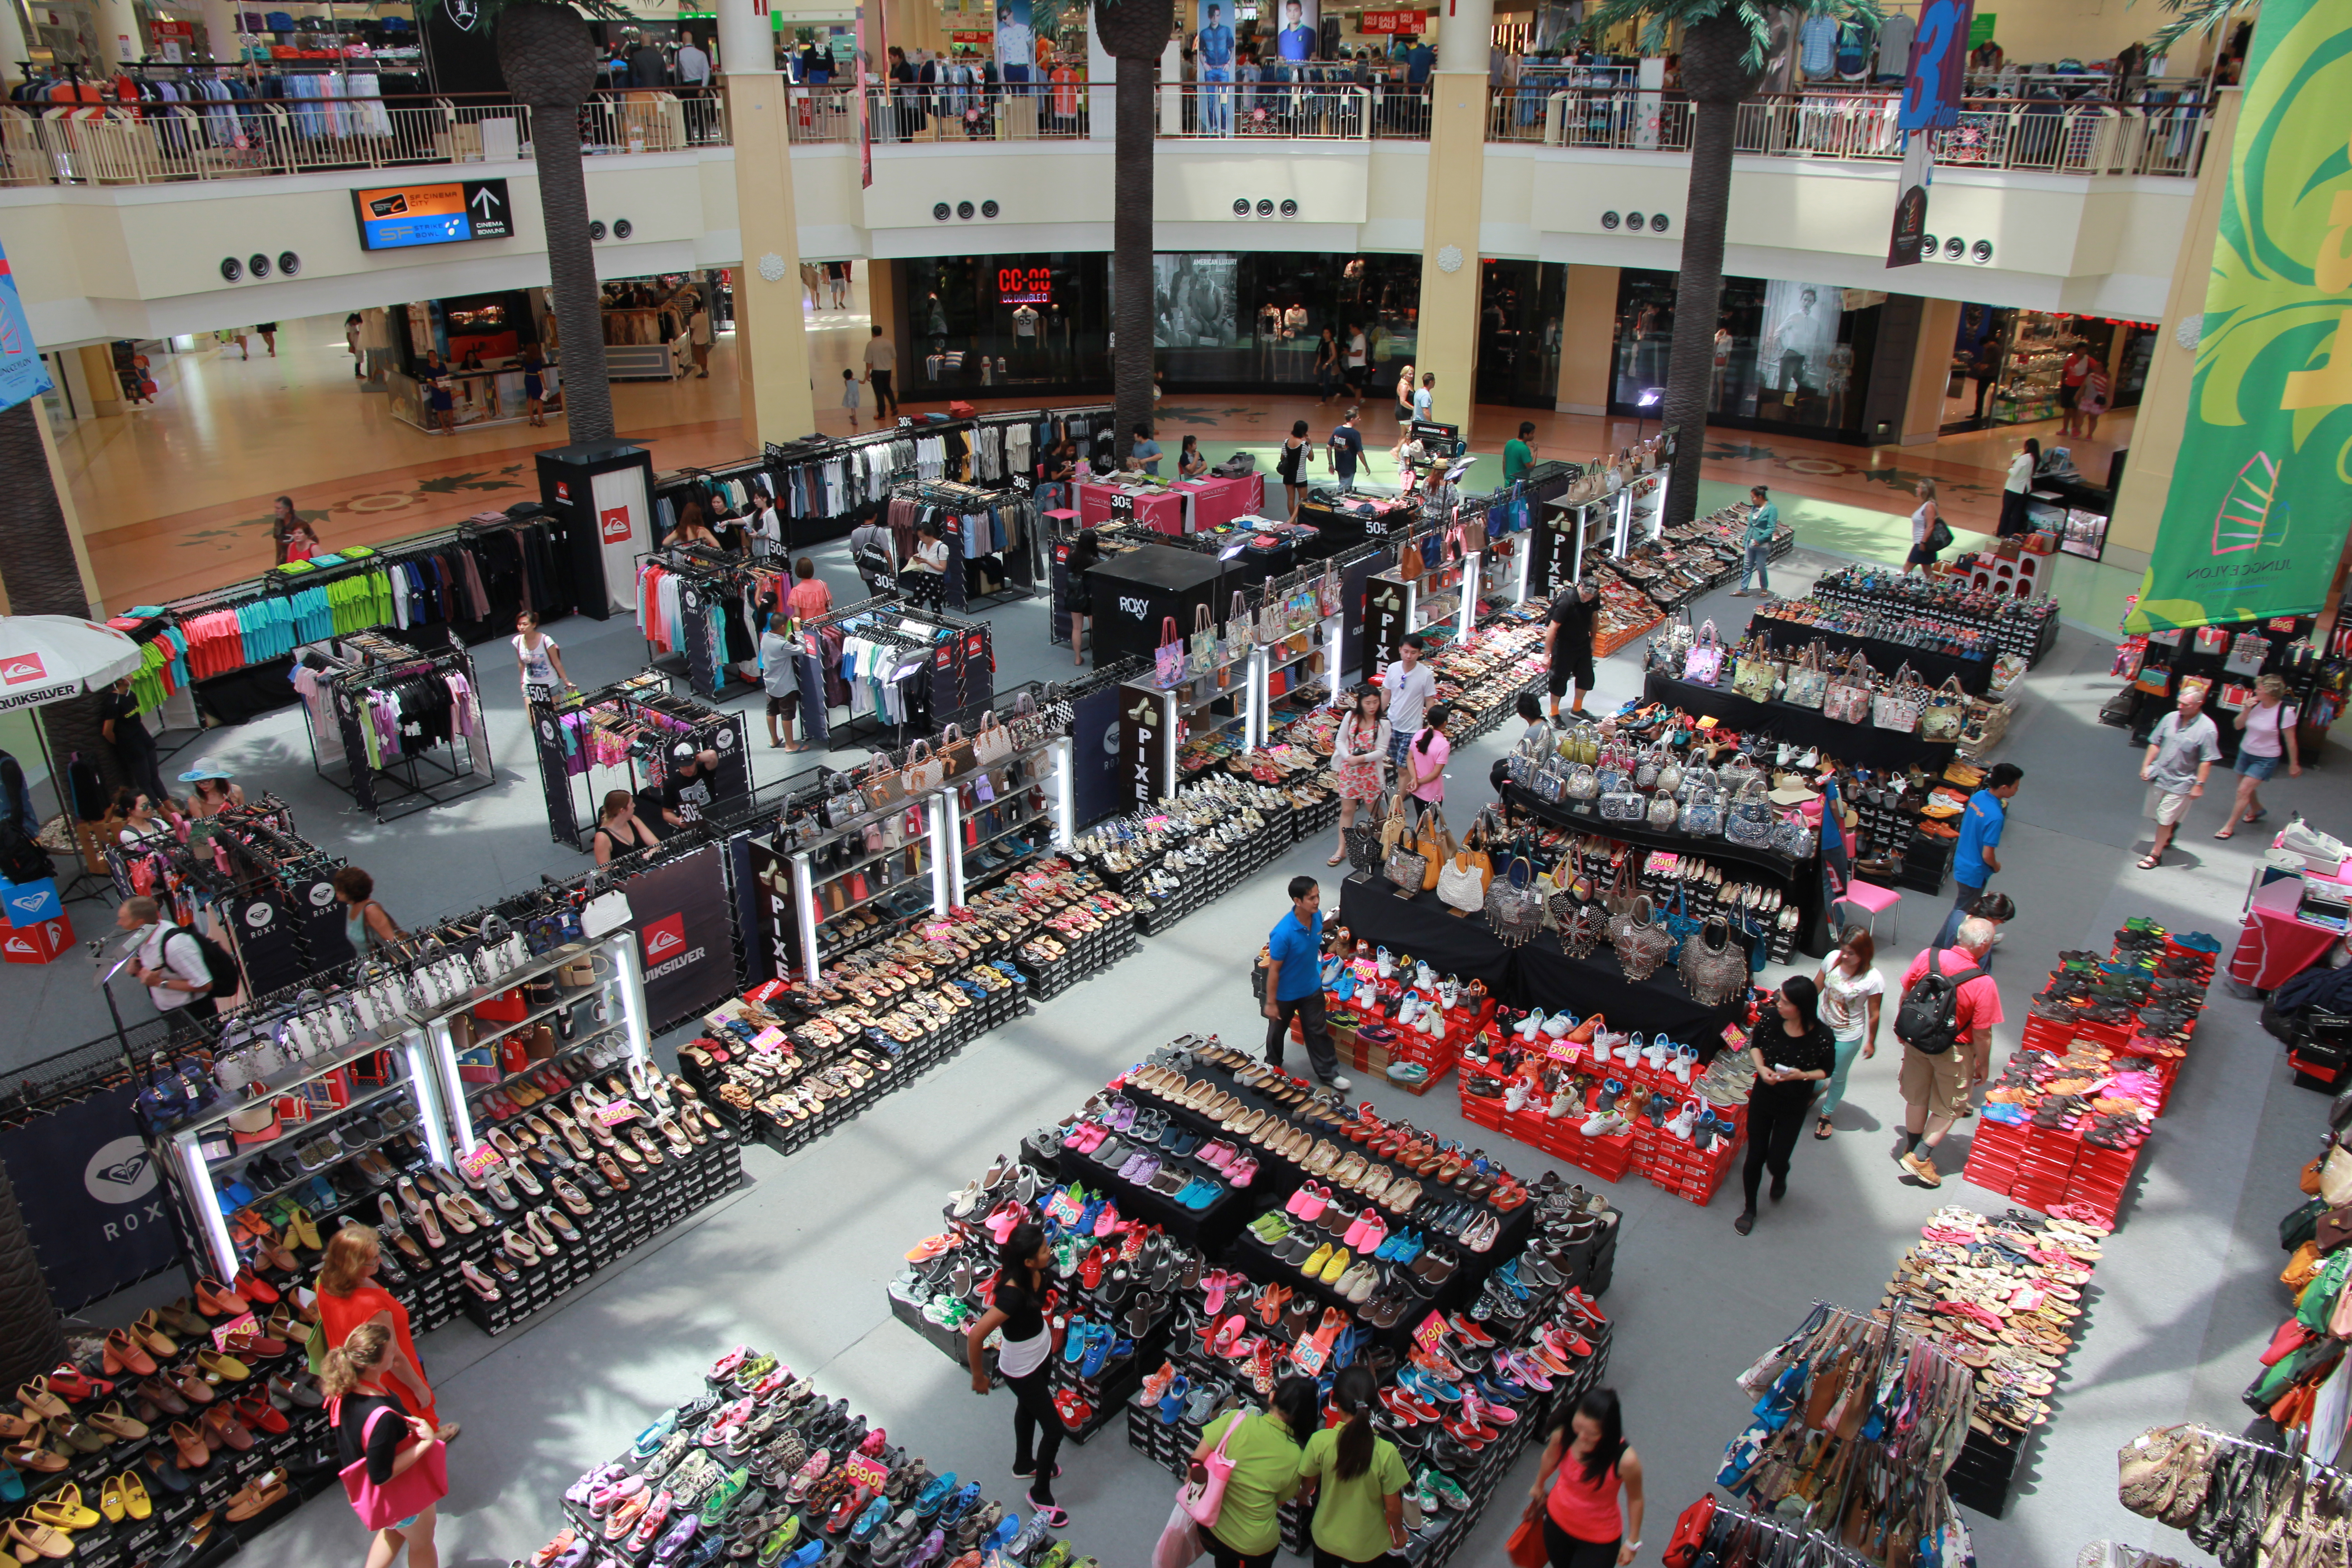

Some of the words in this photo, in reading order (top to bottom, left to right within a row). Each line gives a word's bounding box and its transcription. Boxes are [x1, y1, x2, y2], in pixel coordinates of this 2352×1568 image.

[1003, 294, 1013, 303] CC
[1014, 293, 1040, 303] DOUBLE
[1018, 315, 1031, 326] 65
[898, 416, 907, 427] 30
[766, 443, 776, 456] 30
[1014, 475, 1024, 488] 30
[1199, 486, 1230, 497] JUNGCEYLON
[1111, 495, 1125, 508] 30
[1366, 521, 1380, 534] 50
[770, 539, 782, 555] 50
[874, 573, 889, 588] 30
[1119, 596, 1149, 615] ROXY
[449, 630, 461, 650] 50
[0, 685, 75, 710] QUIKSILVER
[529, 686, 544, 702] 50
[718, 747, 735, 759] ROXY
[679, 803, 696, 822] 50
[1147, 819, 1164, 831] 79
[1028, 877, 1045, 888] 490
[313, 903, 338, 917] ROXY
[250, 923, 276, 939] ROXY
[642, 947, 706, 984] UIKSILVER
[1352, 963, 1372, 977] 590
[752, 1034, 762, 1043] SALE
[758, 1032, 779, 1050] 490
[1725, 1030, 1741, 1047] 790
[1549, 1044, 1575, 1058] 590
[601, 1107, 627, 1122] 590
[462, 1156, 473, 1165] SALE
[467, 1152, 494, 1172] 590
[1056, 1191, 1068, 1202] SALE
[1049, 1200, 1076, 1222] 790
[103, 1201, 164, 1242] ROX
[214, 1324, 229, 1335] SALE
[218, 1322, 251, 1346] 70
[1414, 1324, 1425, 1338] SALE
[1419, 1321, 1444, 1348] 790
[1301, 1332, 1314, 1344] SALE
[1295, 1341, 1320, 1367] 790
[850, 1453, 865, 1464] SALE
[848, 1462, 879, 1487] 690
